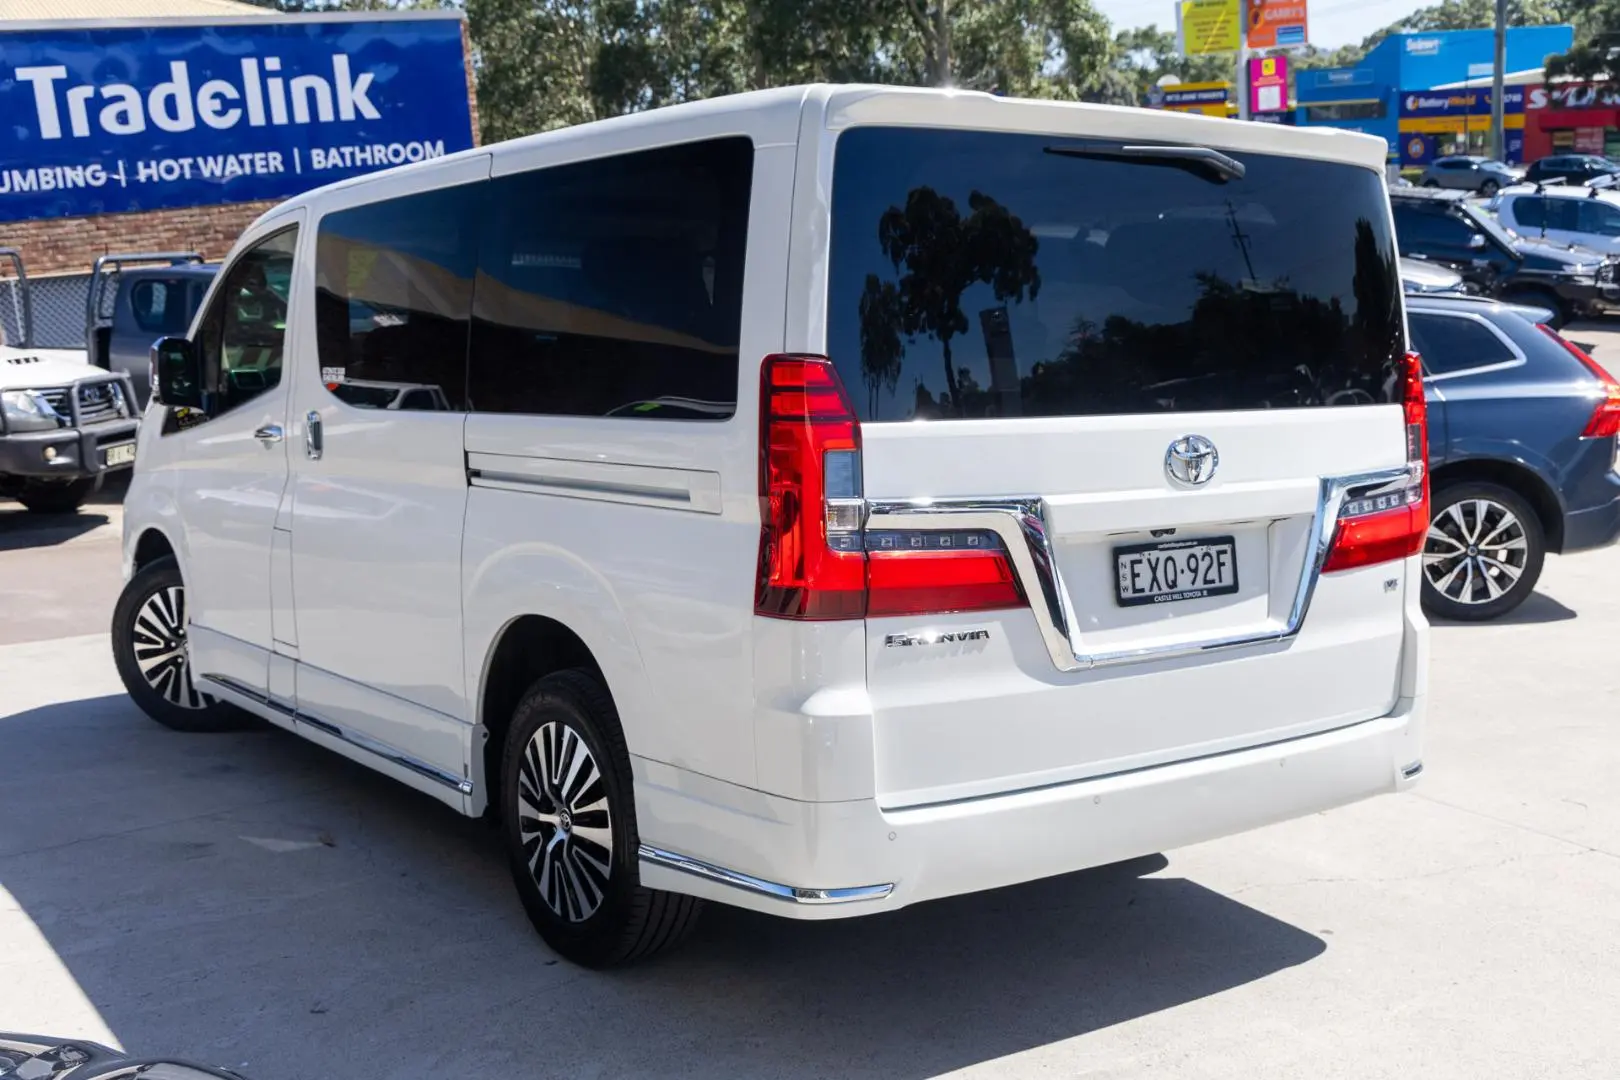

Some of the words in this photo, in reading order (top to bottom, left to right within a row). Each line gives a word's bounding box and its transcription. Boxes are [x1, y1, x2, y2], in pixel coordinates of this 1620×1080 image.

[15, 53, 381, 140] Tradelink
[137, 156, 193, 183] HOT
[200, 151, 284, 178] WATER
[311, 140, 445, 170] BATHROOM
